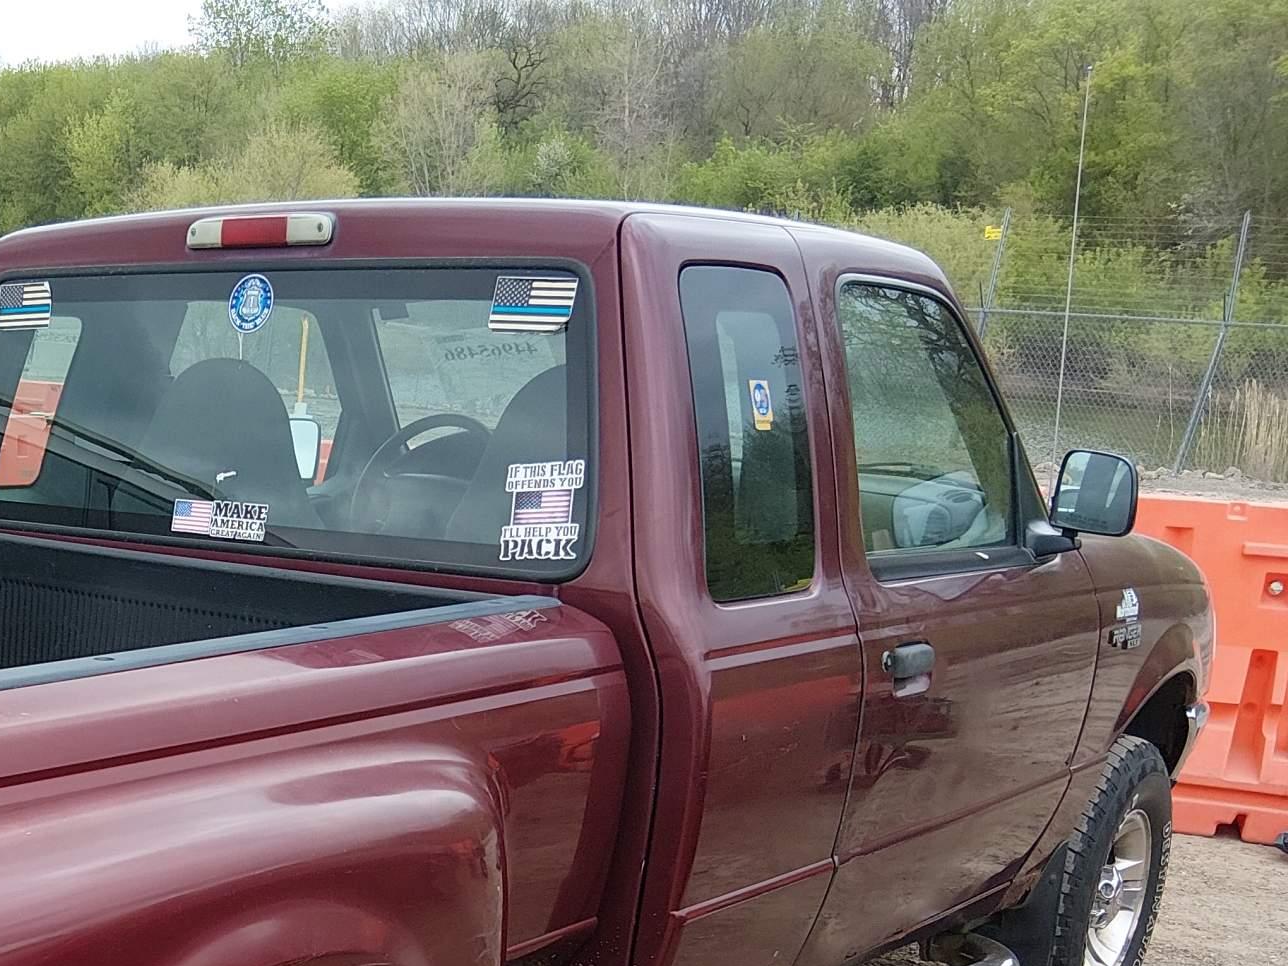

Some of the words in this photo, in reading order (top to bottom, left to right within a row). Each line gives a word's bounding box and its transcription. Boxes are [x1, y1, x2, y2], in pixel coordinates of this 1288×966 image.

[509, 466, 520, 478] IF
[523, 465, 547, 477] THIS
[550, 462, 583, 477] FLAG
[508, 479, 556, 490] OFFENDS
[560, 477, 582, 488] YOU
[214, 501, 267, 520] MAKE
[212, 519, 264, 532] AMERICA
[503, 528, 521, 539] I'LL
[524, 526, 552, 537] HELP
[556, 525, 578, 537] YOU
[502, 538, 576, 558] PACK
